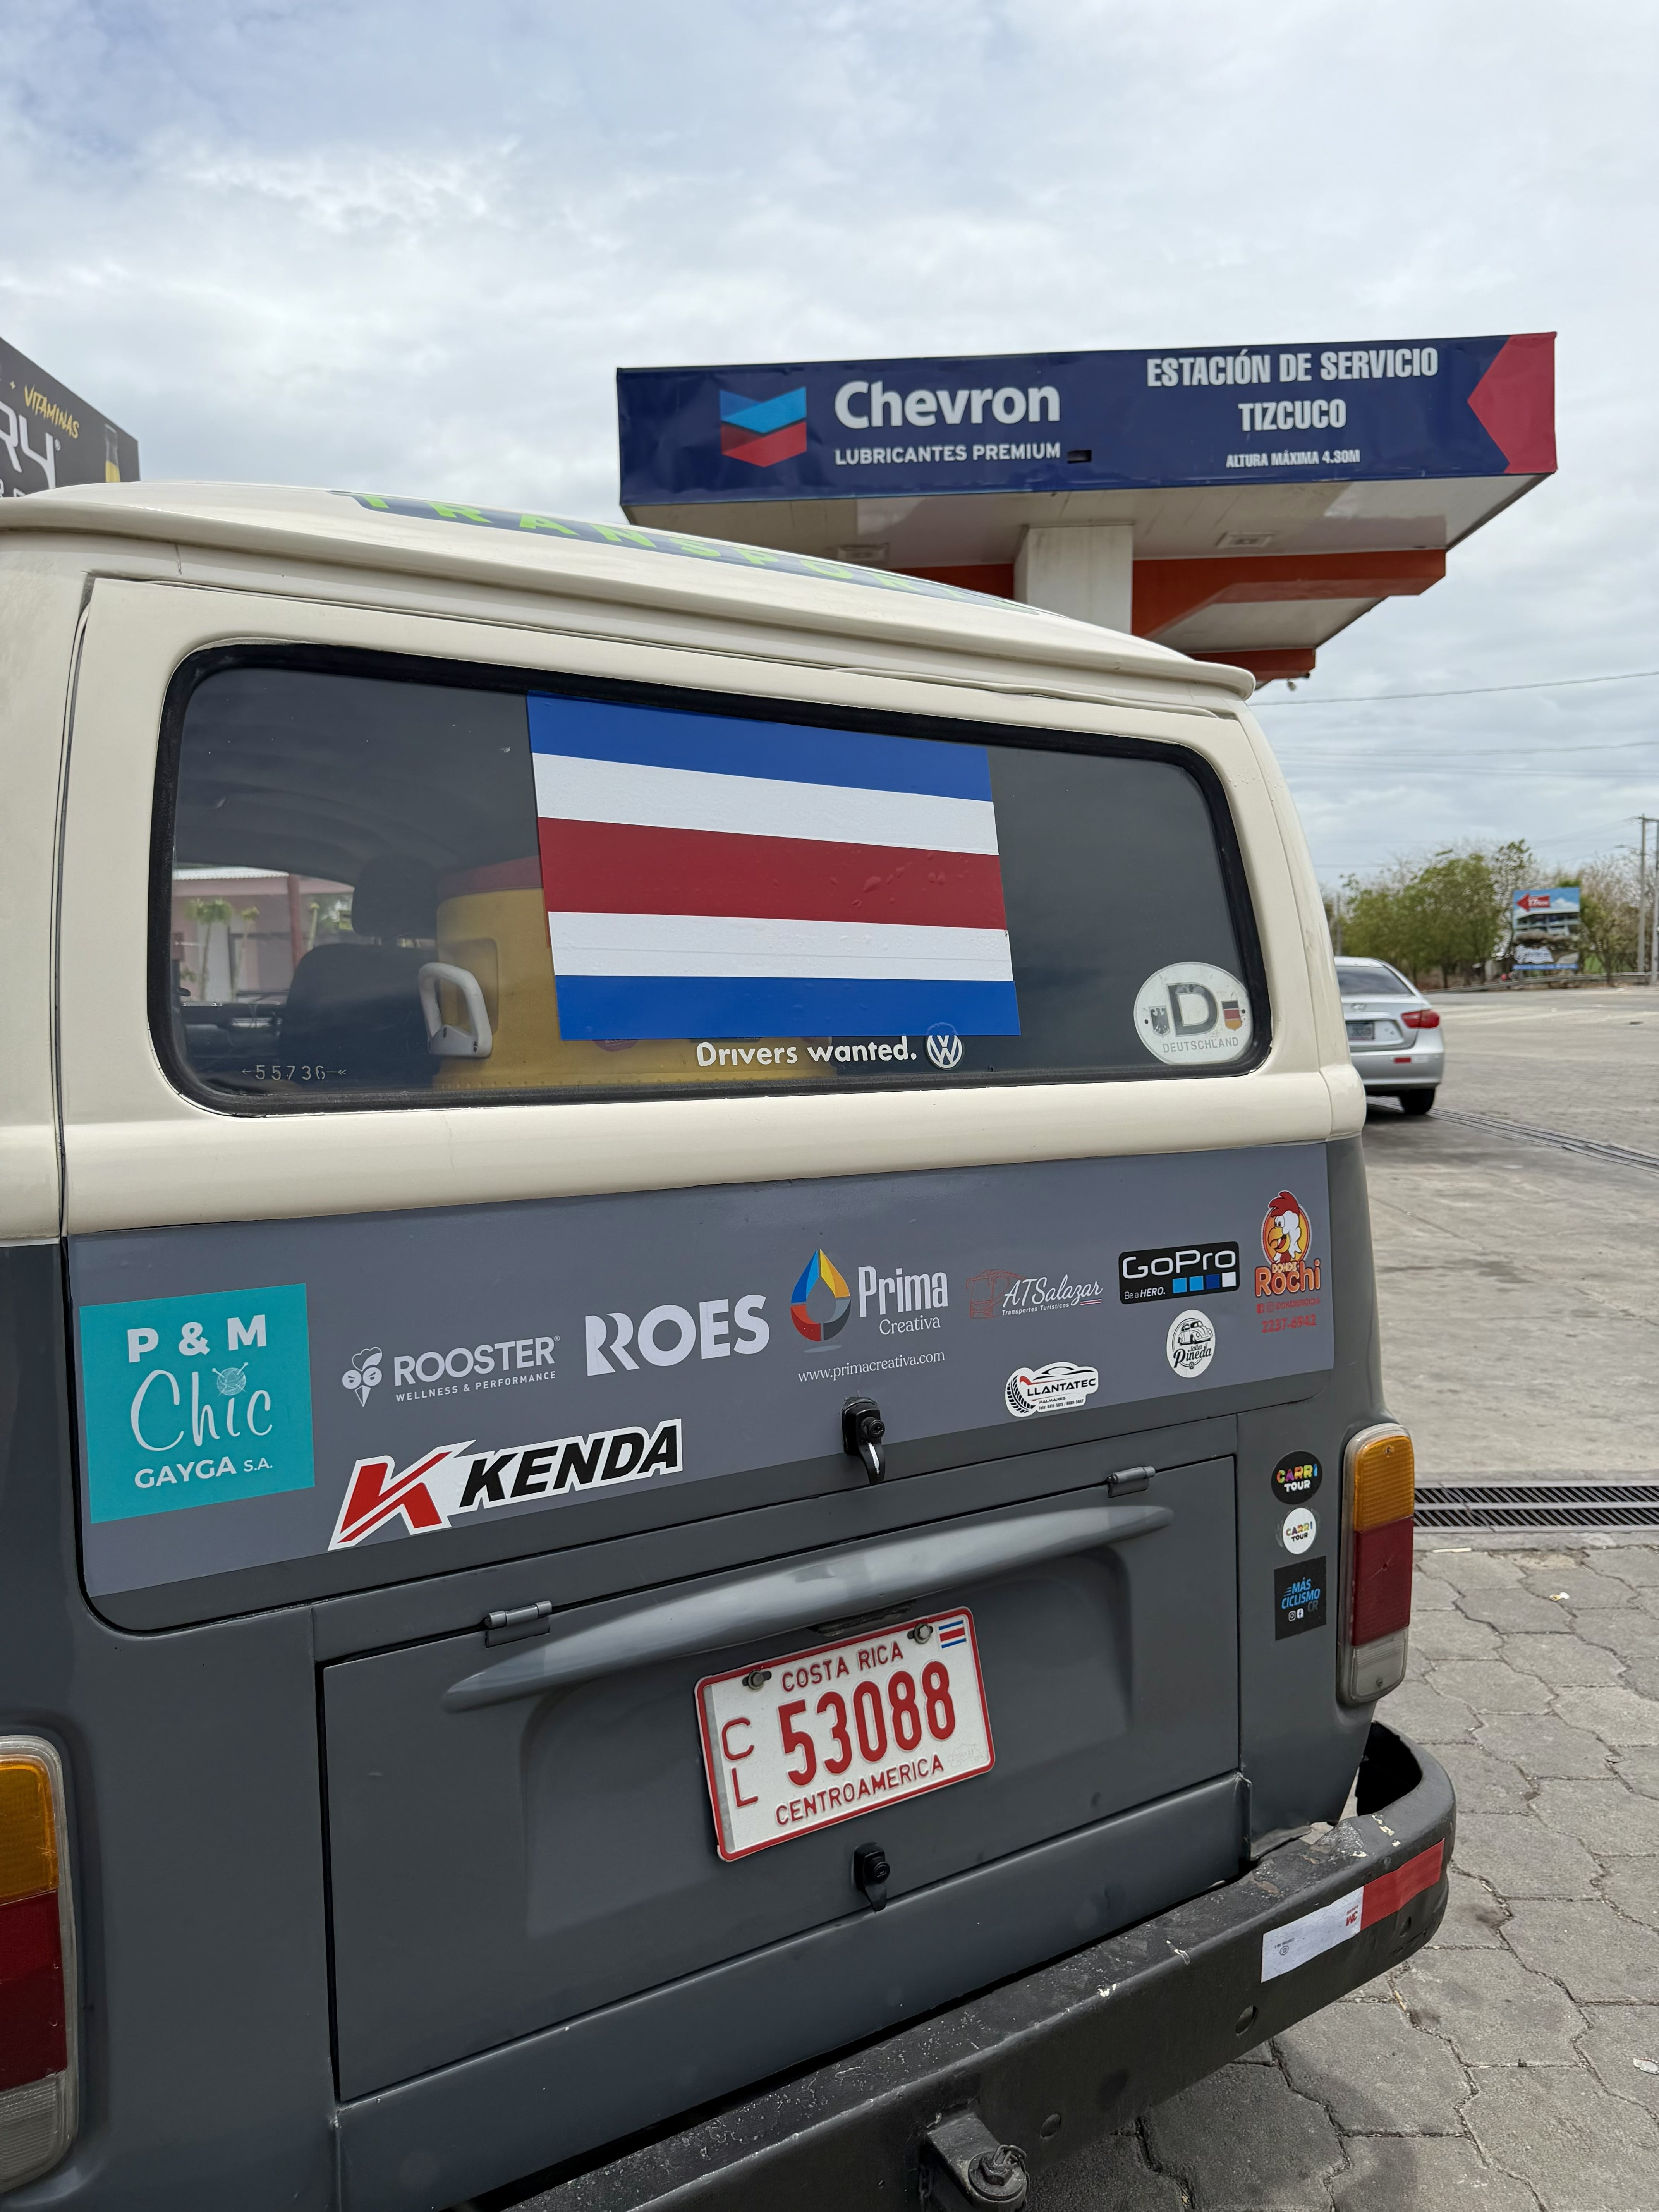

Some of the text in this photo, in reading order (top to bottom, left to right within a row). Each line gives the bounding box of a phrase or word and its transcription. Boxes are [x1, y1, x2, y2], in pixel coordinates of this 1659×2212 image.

[1147, 347, 1438, 386] ESTACIÓN DE SERVICIO
[24, 385, 79, 439] VITAMINAS
[834, 380, 1060, 429] Chevron
[1238, 398, 1347, 431] TIZCUCO
[835, 442, 1061, 465] LUBRICANTES PREMIUM
[1226, 453, 1269, 468] ALTURA
[1271, 449, 1319, 466] MÁXIMA
[1166, 982, 1219, 1037] D
[697, 1041, 798, 1066] Drivers
[807, 1035, 917, 1063] wanted.
[1163, 1037, 1239, 1053] DEUTSCHLAND
[256, 1065, 326, 1080] 55736
[1122, 1250, 1236, 1279] GoPro
[1255, 1258, 1321, 1298] Rochi
[1272, 1261, 1297, 1274] DONDE
[858, 1266, 948, 1317] Prima
[1140, 1287, 1166, 1298] HERO.
[1002, 1303, 1069, 1316] Transportes Turísticos
[127, 1314, 267, 1363] P & M
[879, 1315, 941, 1335] Creativa
[394, 1336, 555, 1386] ROOSTER
[798, 1352, 945, 1382] www.primacreativa.com
[1173, 1346, 1212, 1369] Pineda
[396, 1370, 557, 1402] WELLNESS & PERFORMANCE
[1027, 1378, 1096, 1397] LLANTATEC
[131, 1363, 273, 1451] Chic
[134, 1456, 273, 1489] GAYGA S.A.
[459, 1425, 677, 1508] KENDA
[1284, 1479, 1311, 1492] TOUR
[1286, 1521, 1312, 1537] CARRI
[1291, 1532, 1308, 1542] TOUR
[1281, 1588, 1321, 1610] CICLISMO
[1292, 1577, 1312, 1595] MÁS
[1307, 1600, 1319, 1613] CR
[781, 1641, 904, 1693] COSTA RICA
[777, 1660, 957, 1787] 53088
[775, 1753, 944, 1826] CENTROAMERICA
